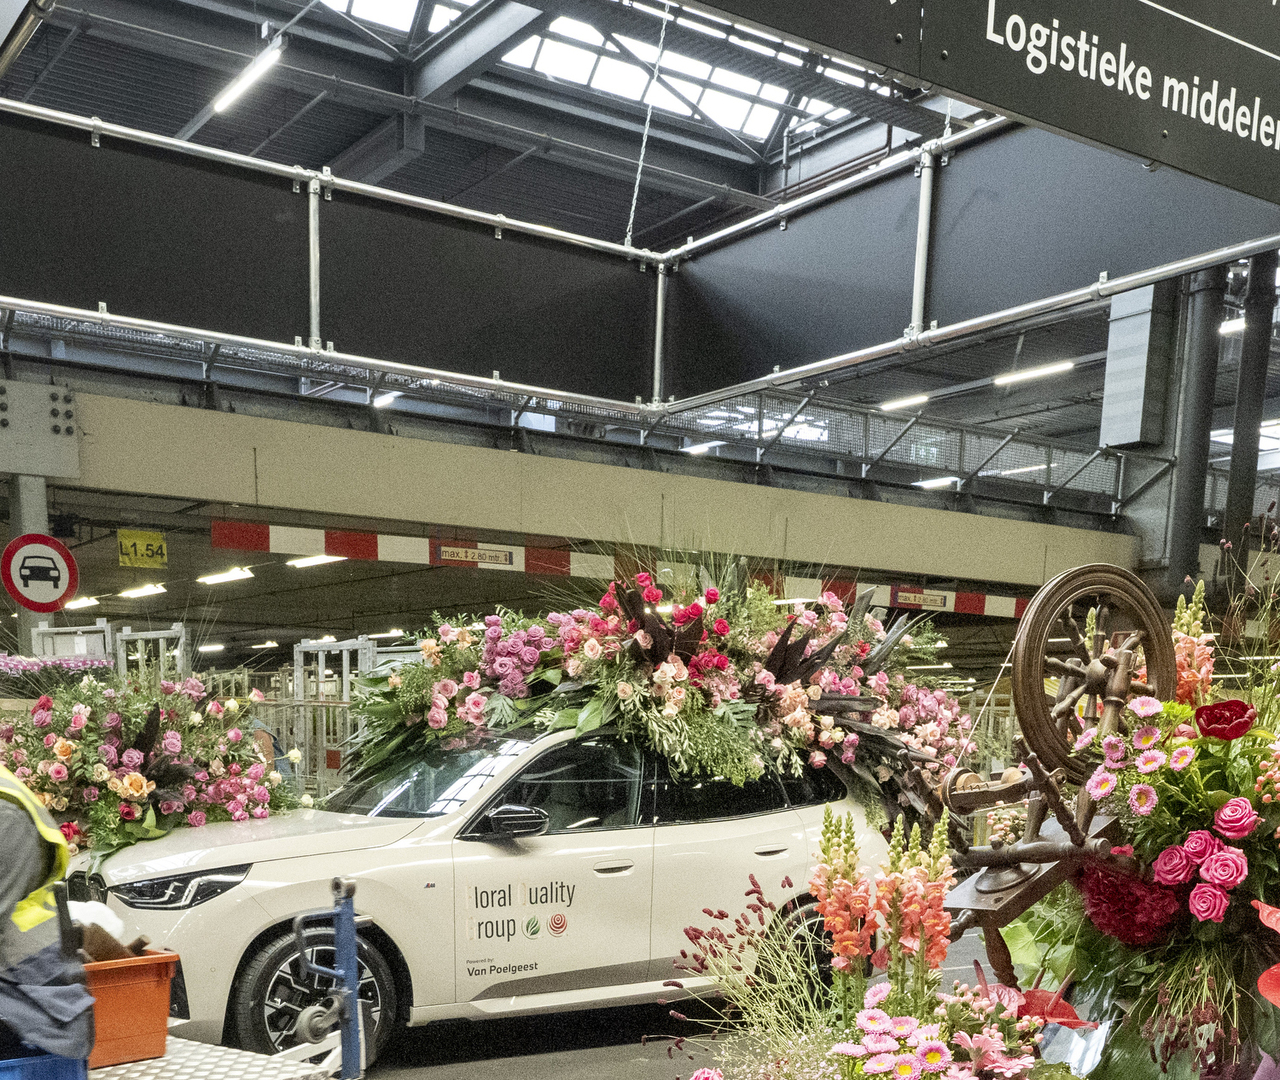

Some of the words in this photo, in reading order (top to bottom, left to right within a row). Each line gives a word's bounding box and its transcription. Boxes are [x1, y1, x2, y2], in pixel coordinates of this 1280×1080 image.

[985, 0, 1153, 101] Logistieke
[119, 540, 166, 559] L1.54
[441, 549, 463, 560] max.
[470, 551, 488, 561] 2.80
[467, 967, 487, 977] Van
[489, 961, 539, 975] Poelgeest
